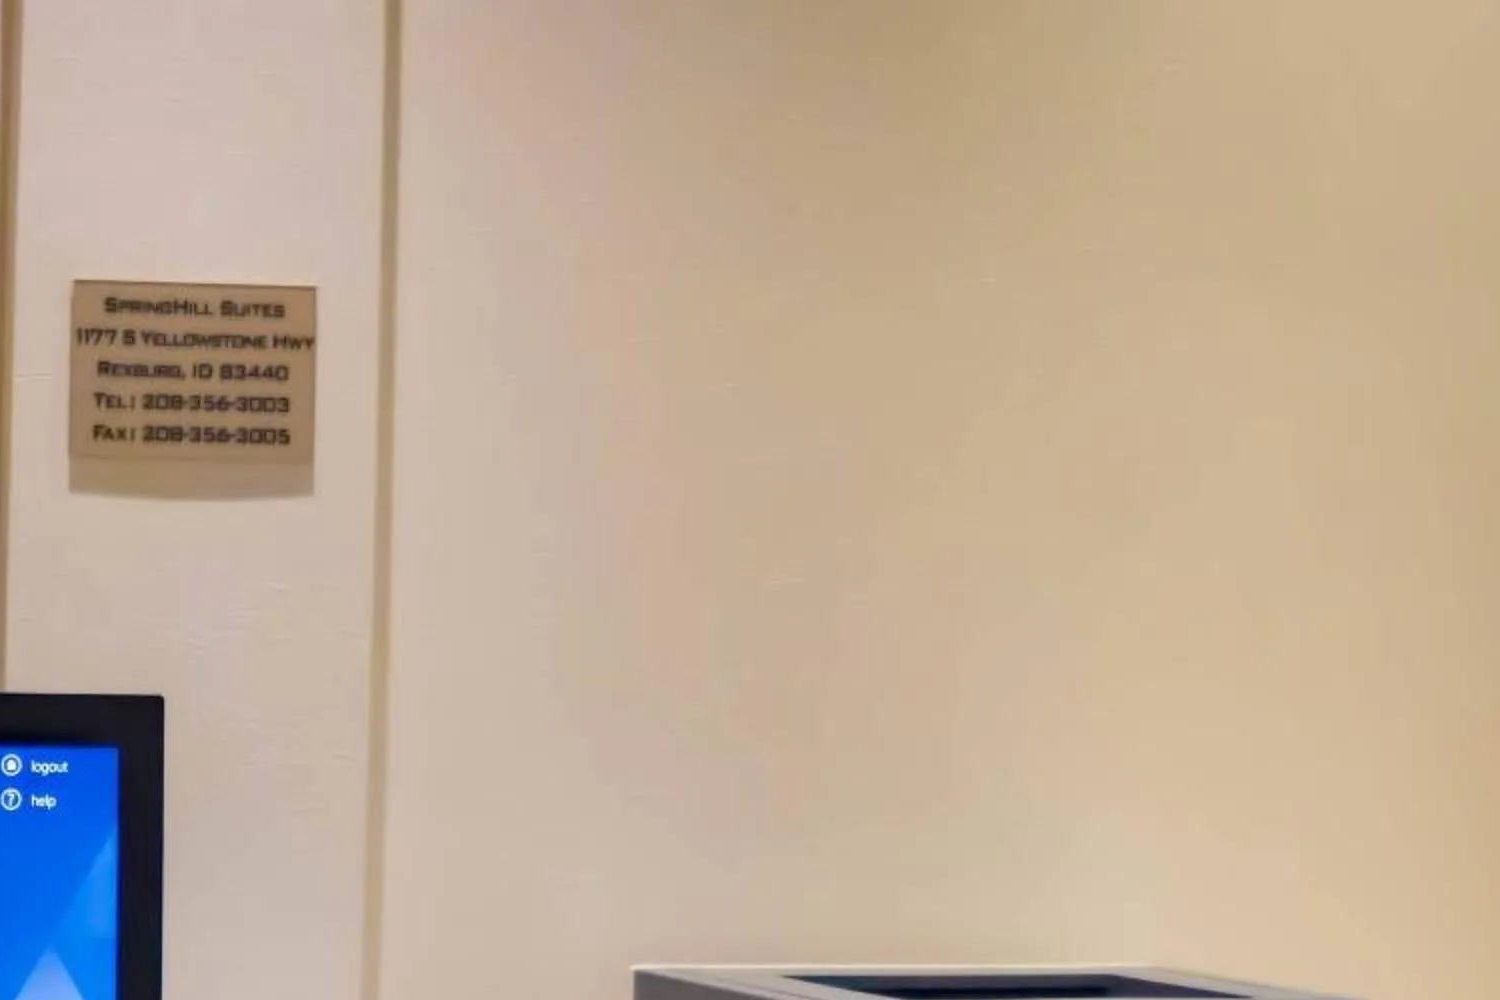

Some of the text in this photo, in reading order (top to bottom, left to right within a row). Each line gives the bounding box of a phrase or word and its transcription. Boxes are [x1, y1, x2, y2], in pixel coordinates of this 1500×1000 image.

[77, 328, 117, 346] 1177
[123, 329, 136, 346] S
[193, 363, 213, 380] ID
[220, 364, 289, 381] 83440
[142, 394, 290, 413] 208-356-3003
[142, 425, 291, 445] 208-356-3005
[31, 760, 69, 777] logout
[31, 793, 57, 810] help
